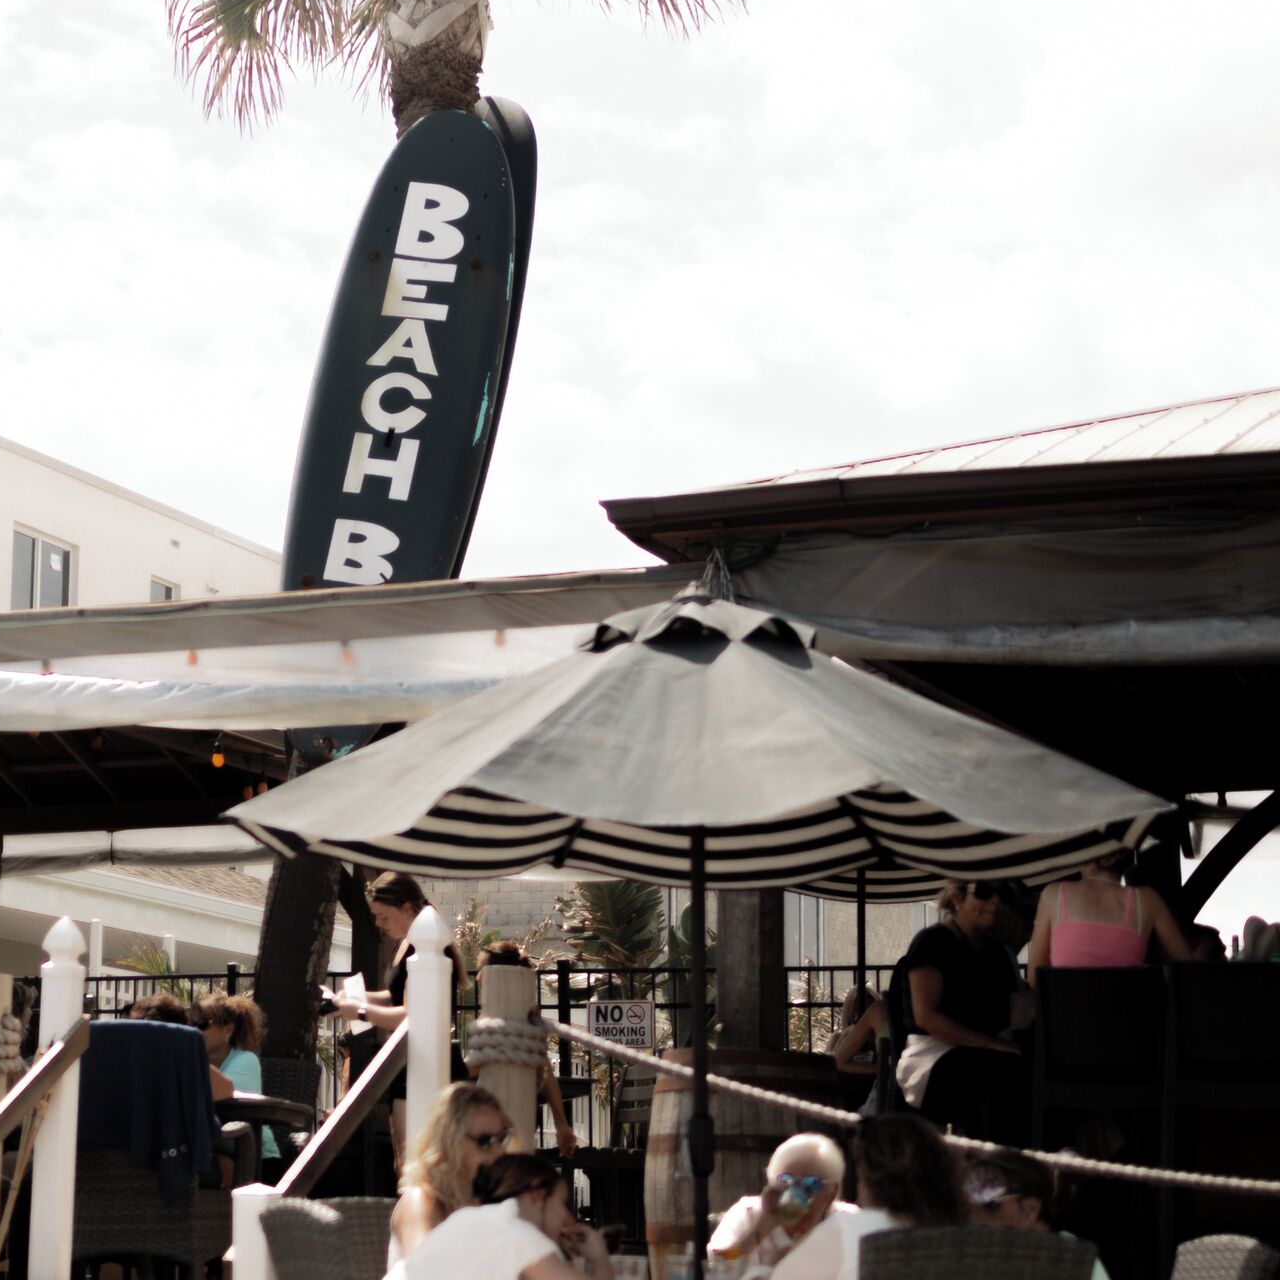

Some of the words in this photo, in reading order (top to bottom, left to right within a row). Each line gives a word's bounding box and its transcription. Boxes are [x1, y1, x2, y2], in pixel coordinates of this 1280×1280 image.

[342, 181, 470, 501] BEACH
[595, 1005, 623, 1023] NO
[594, 1026, 646, 1038] SMOKING
[625, 1038, 646, 1046] AREA
